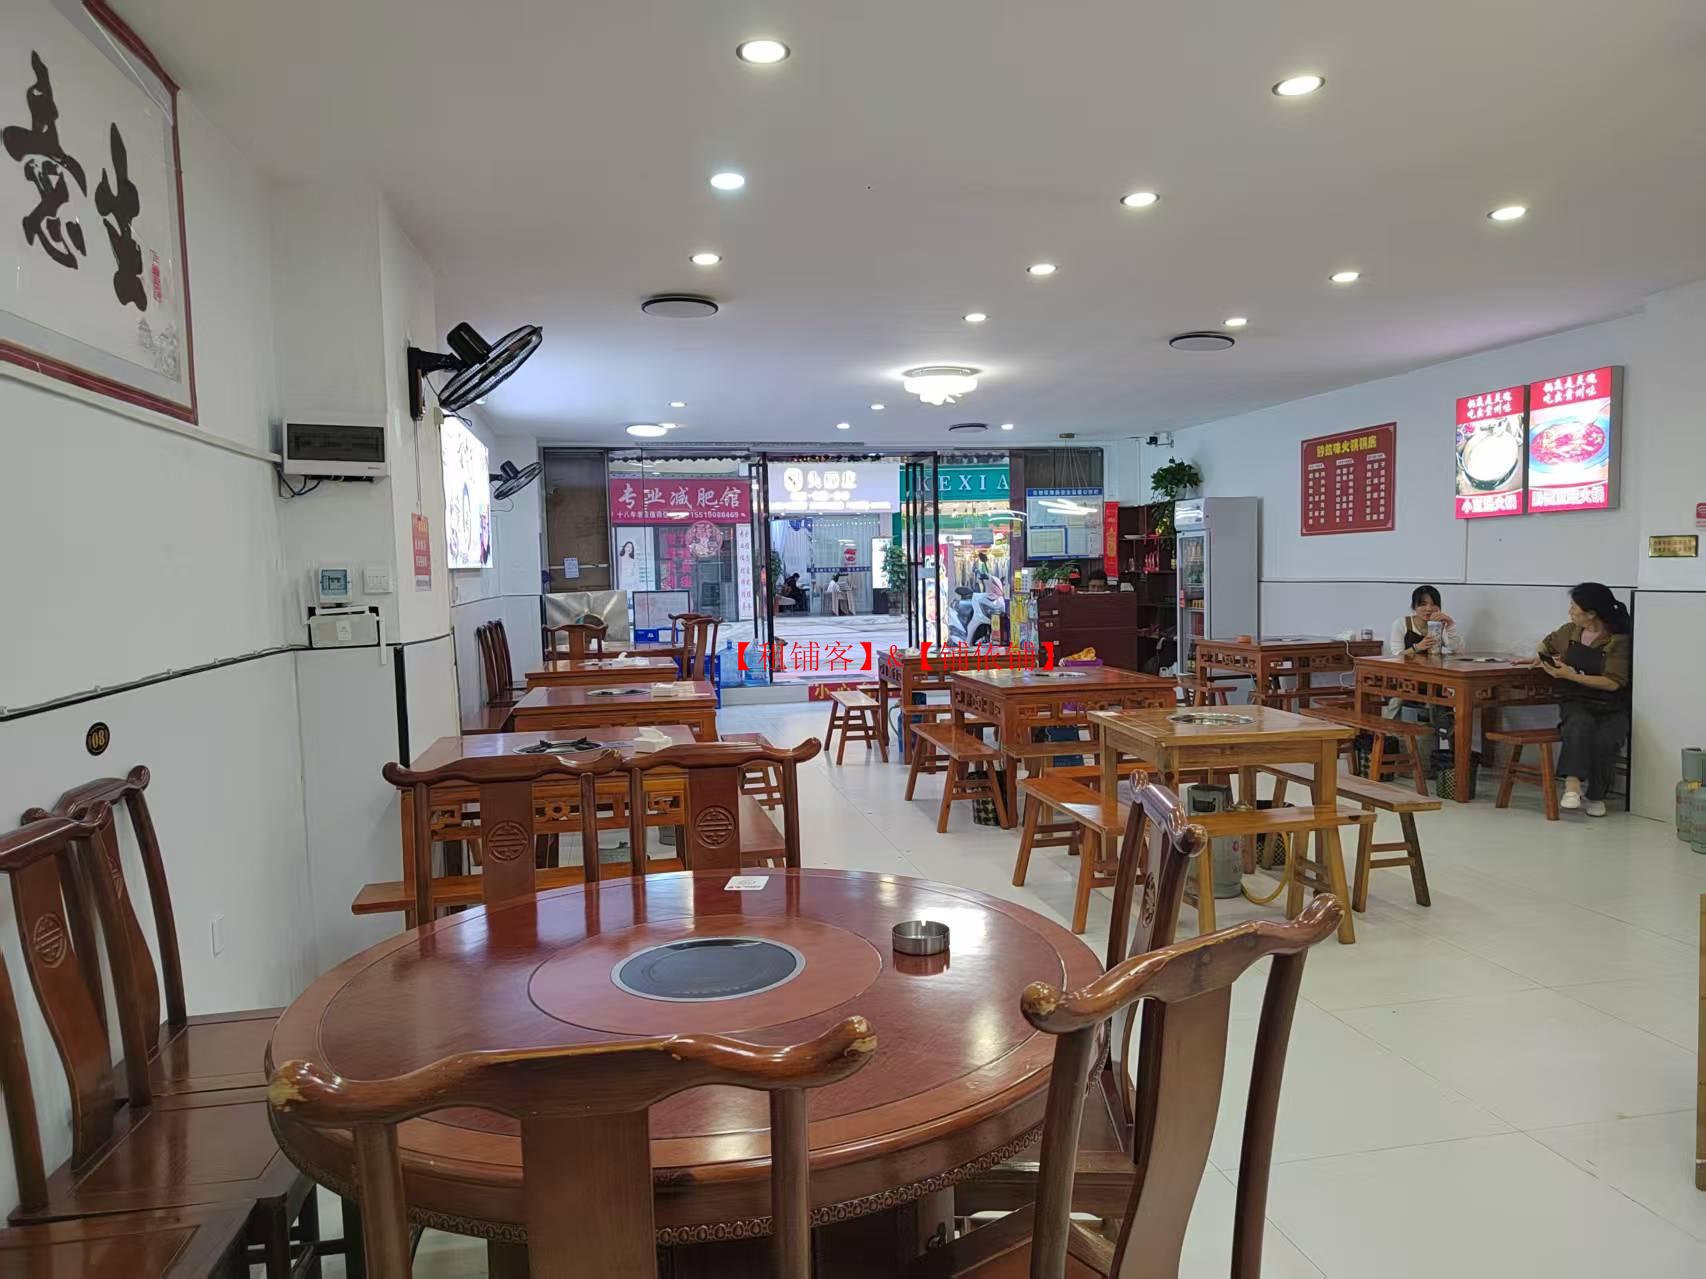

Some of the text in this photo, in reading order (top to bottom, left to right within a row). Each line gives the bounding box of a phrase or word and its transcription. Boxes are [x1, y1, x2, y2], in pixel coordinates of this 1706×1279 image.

[618, 482, 742, 510] 专业减肥馆
[91, 729, 106, 749] 08
